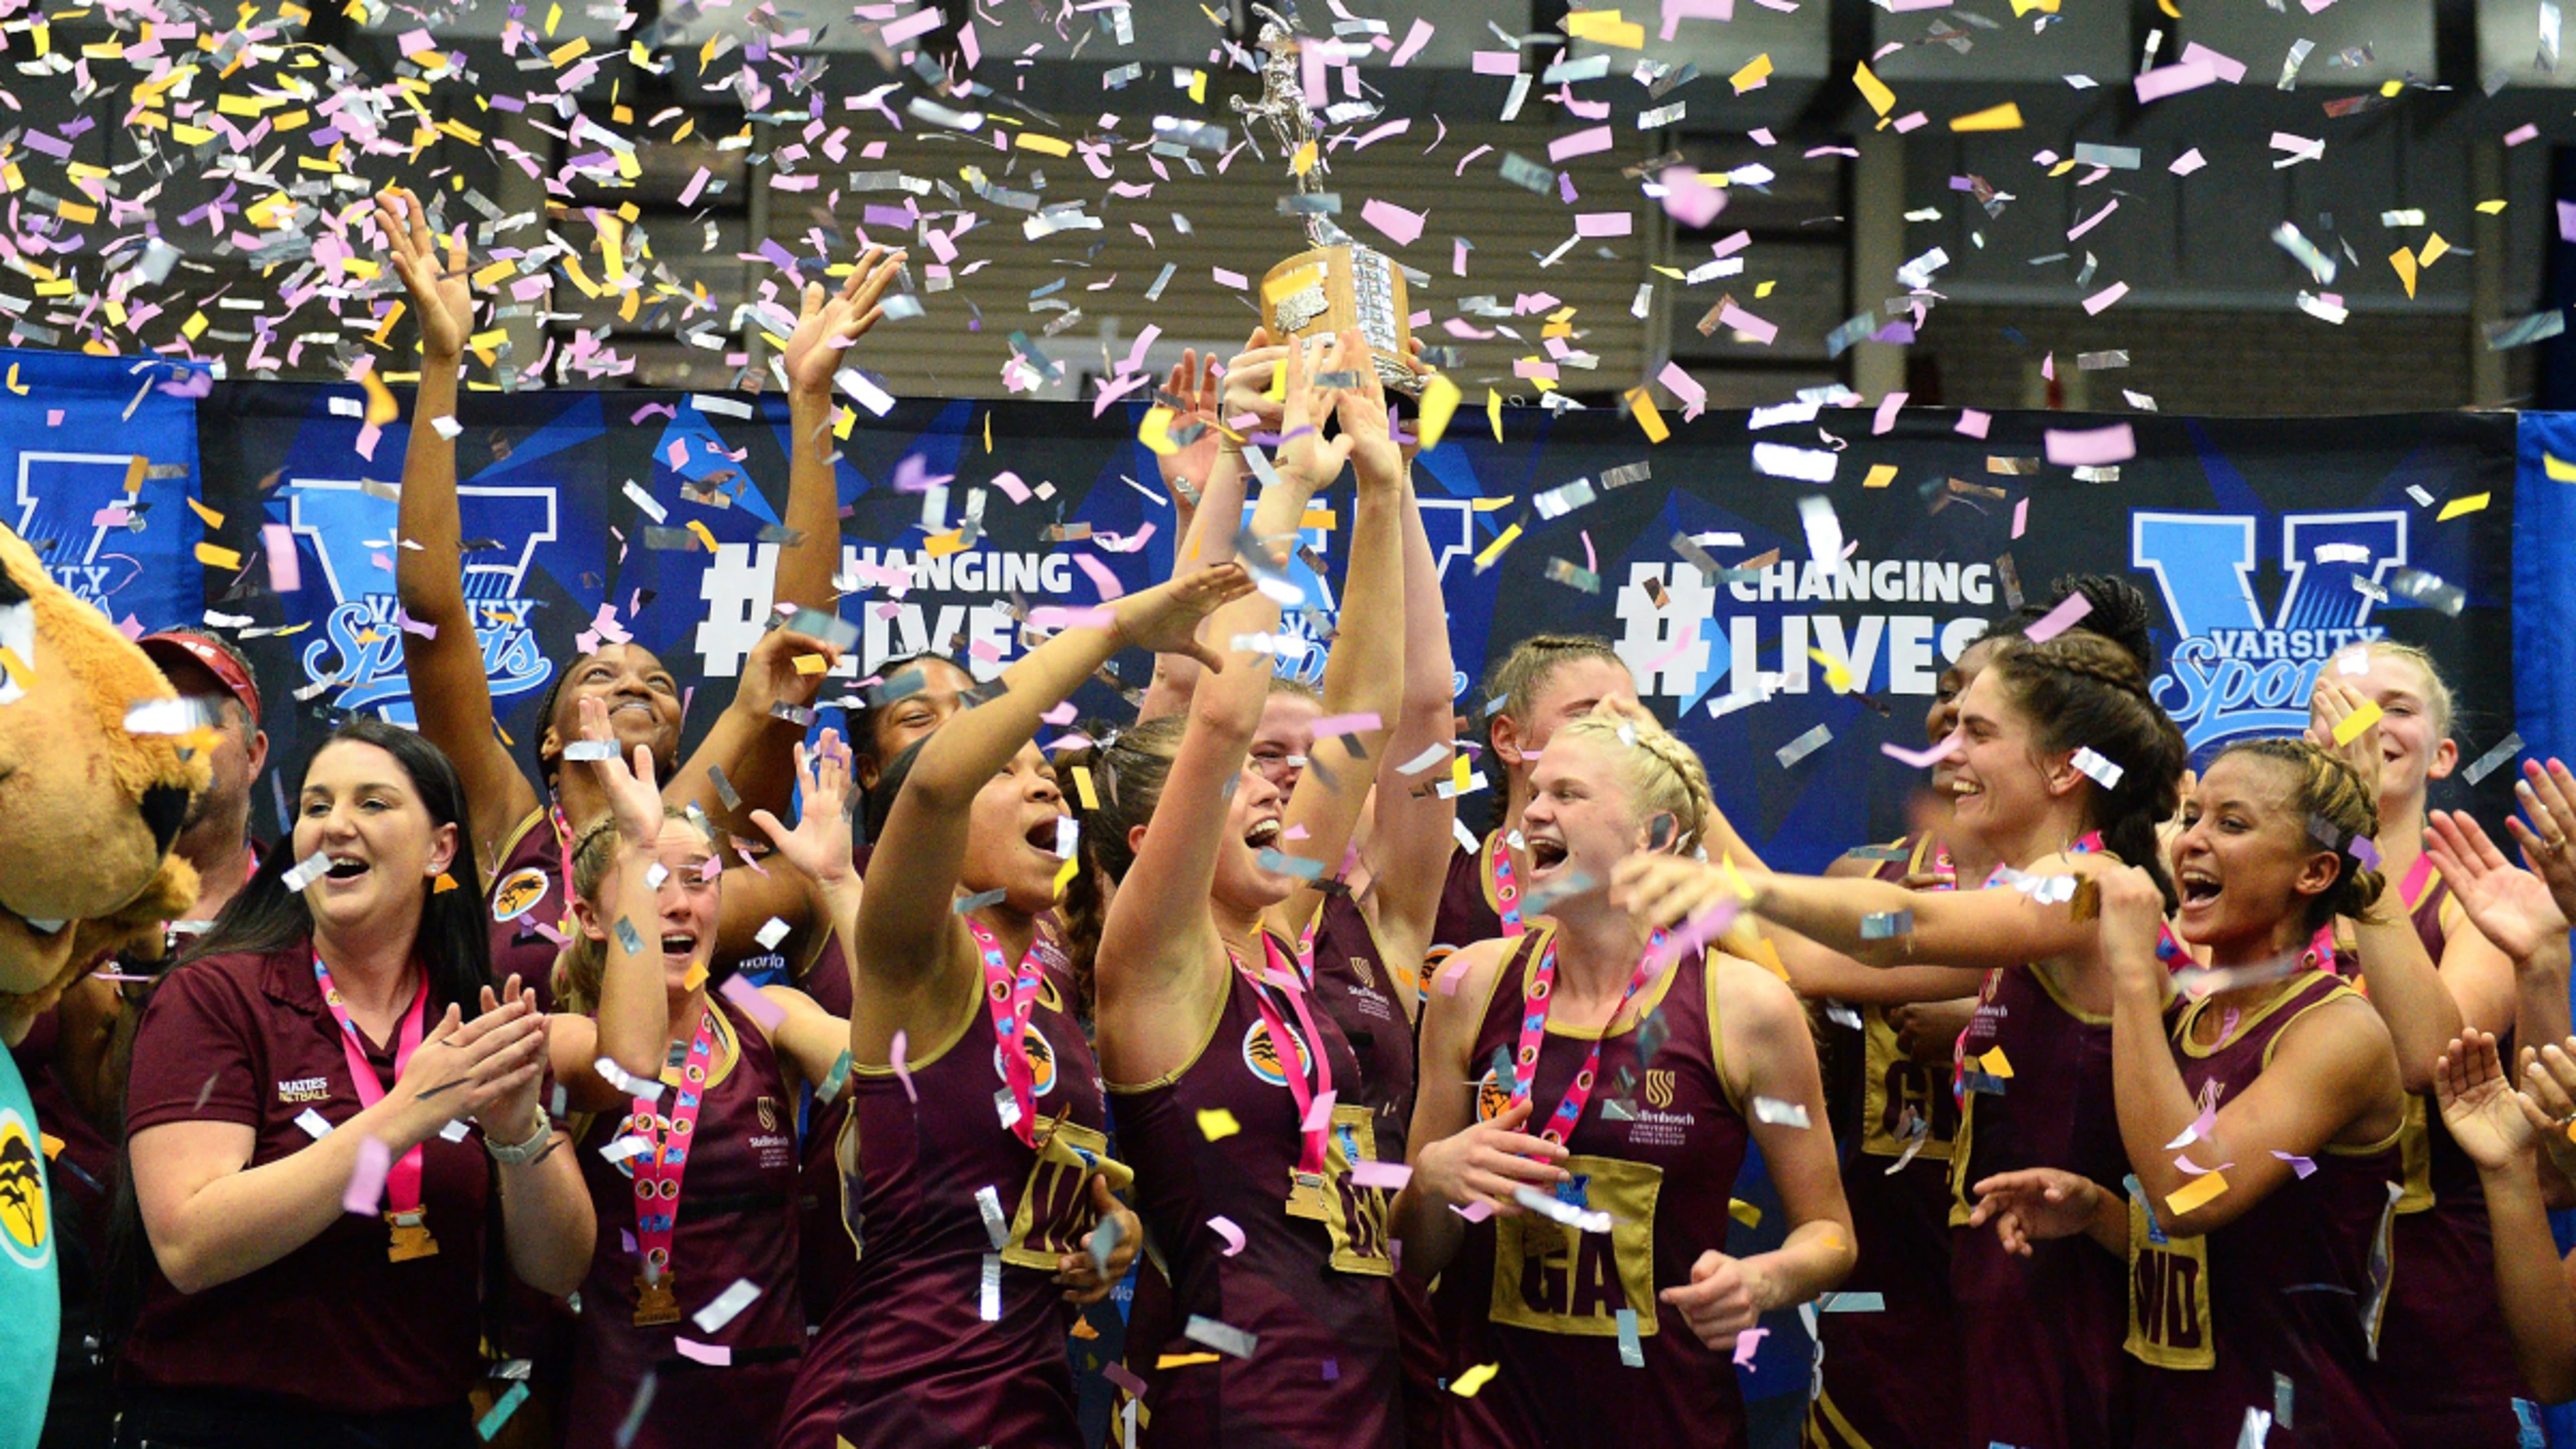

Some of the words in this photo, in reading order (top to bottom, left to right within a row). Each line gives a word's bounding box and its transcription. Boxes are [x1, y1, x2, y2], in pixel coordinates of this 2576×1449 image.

[843, 545, 1071, 593] HANGING
[1729, 559, 1993, 603] CHANGING
[364, 593, 535, 628] VITY
[303, 601, 551, 710] Spts
[2149, 636, 2329, 753] Spor
[1519, 1230, 1630, 1318] GA
